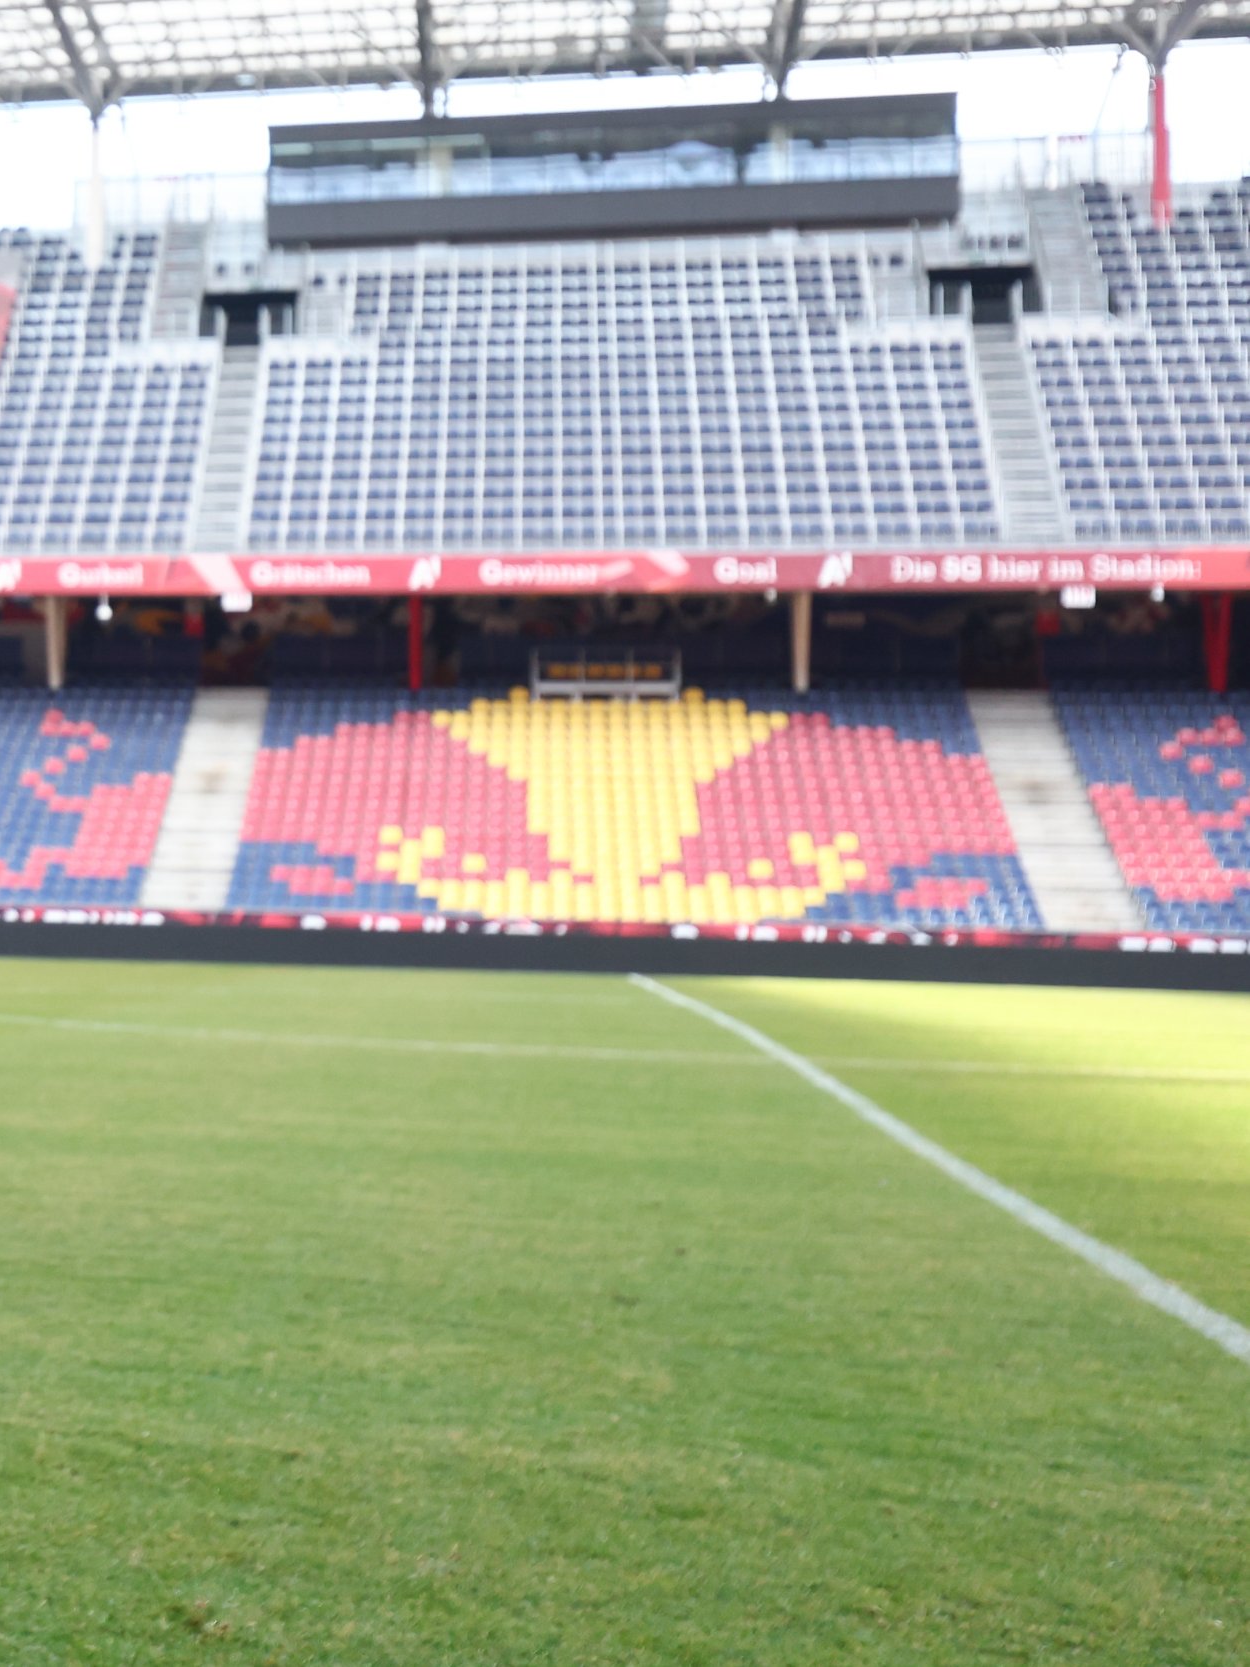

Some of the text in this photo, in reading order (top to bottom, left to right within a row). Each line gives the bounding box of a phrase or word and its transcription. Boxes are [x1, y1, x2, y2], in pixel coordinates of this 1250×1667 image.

[713, 556, 777, 584] Goal
[890, 555, 937, 583] Die
[988, 553, 1043, 582] hier
[1048, 554, 1084, 581] im
